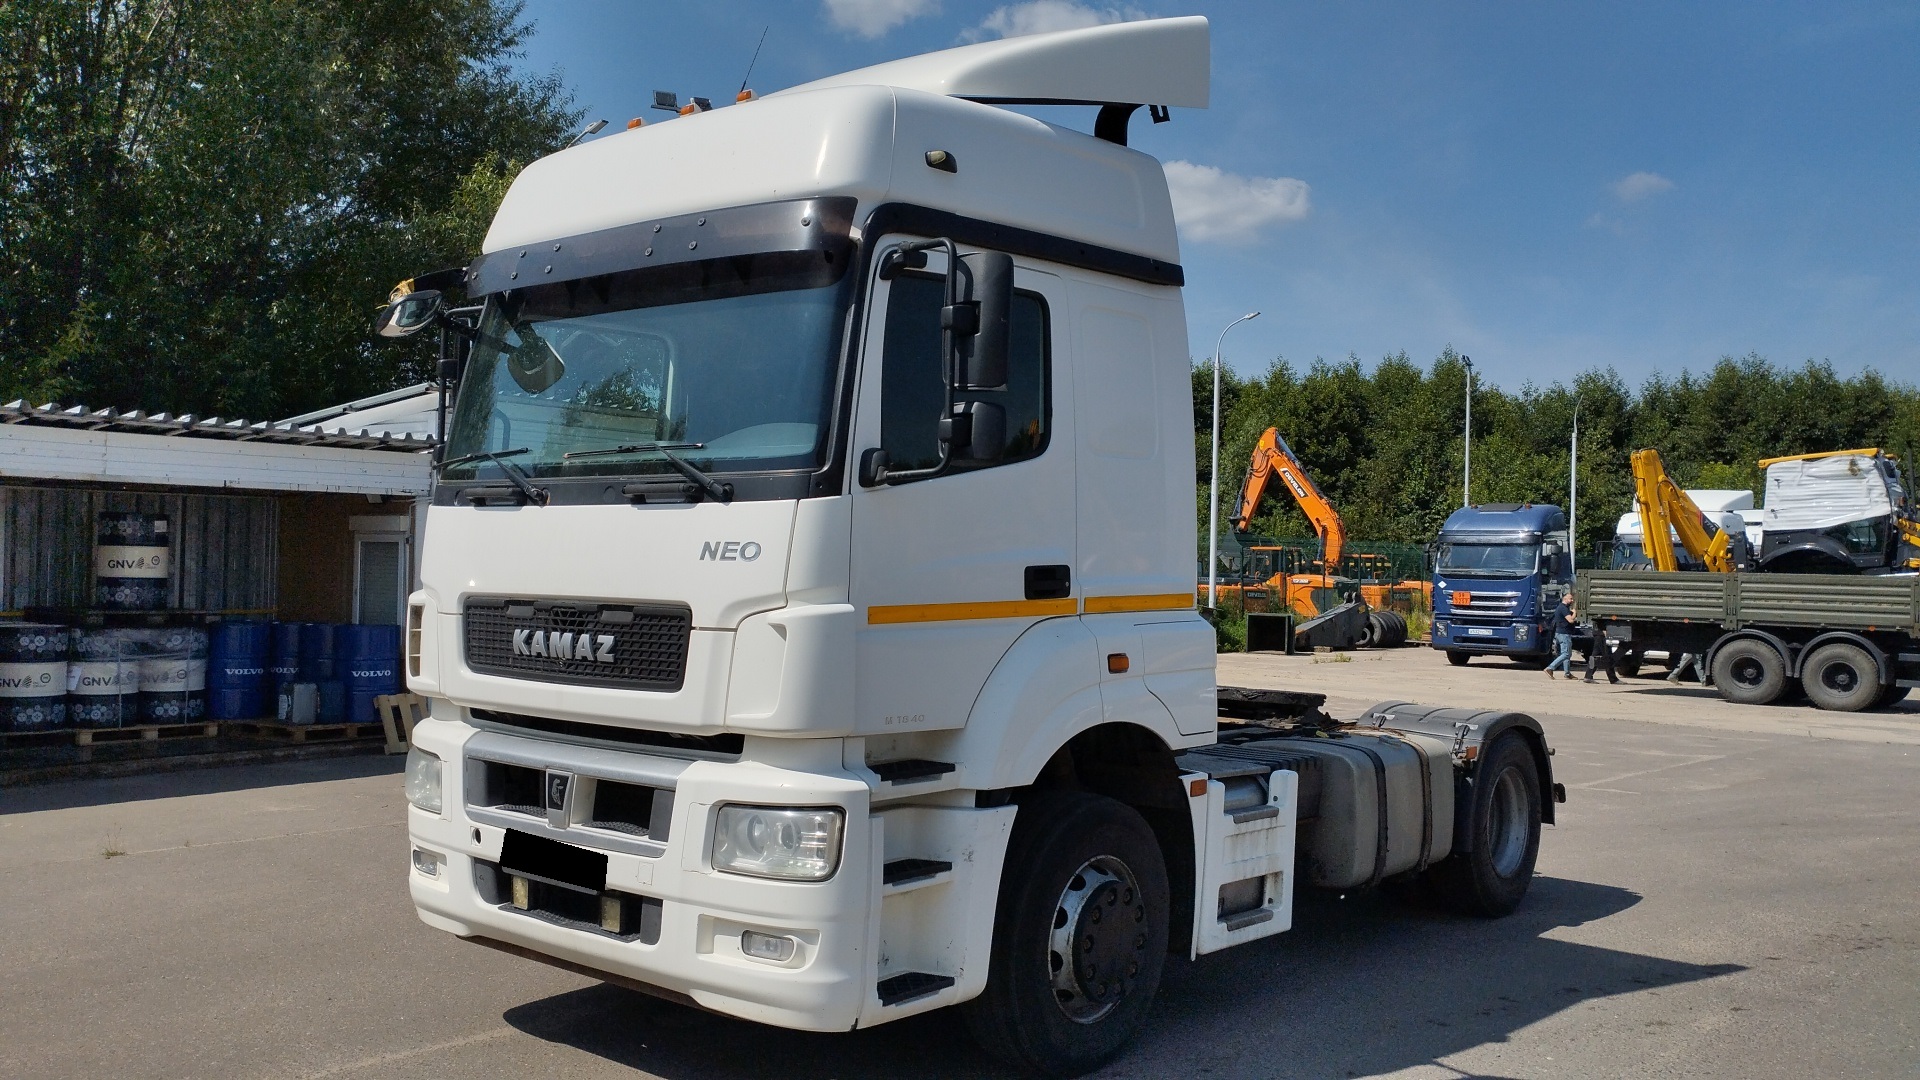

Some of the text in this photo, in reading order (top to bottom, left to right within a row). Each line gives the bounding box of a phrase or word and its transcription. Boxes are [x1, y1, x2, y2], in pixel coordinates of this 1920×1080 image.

[1284, 471, 1305, 498] DEVELON
[699, 541, 762, 562] NEO
[107, 559, 136, 569] GNV
[512, 628, 616, 663] KAMAZ
[224, 667, 264, 676] VOLVO
[270, 667, 299, 675] VOLV
[351, 669, 392, 678] VOLVO
[82, 677, 112, 687] GNV
